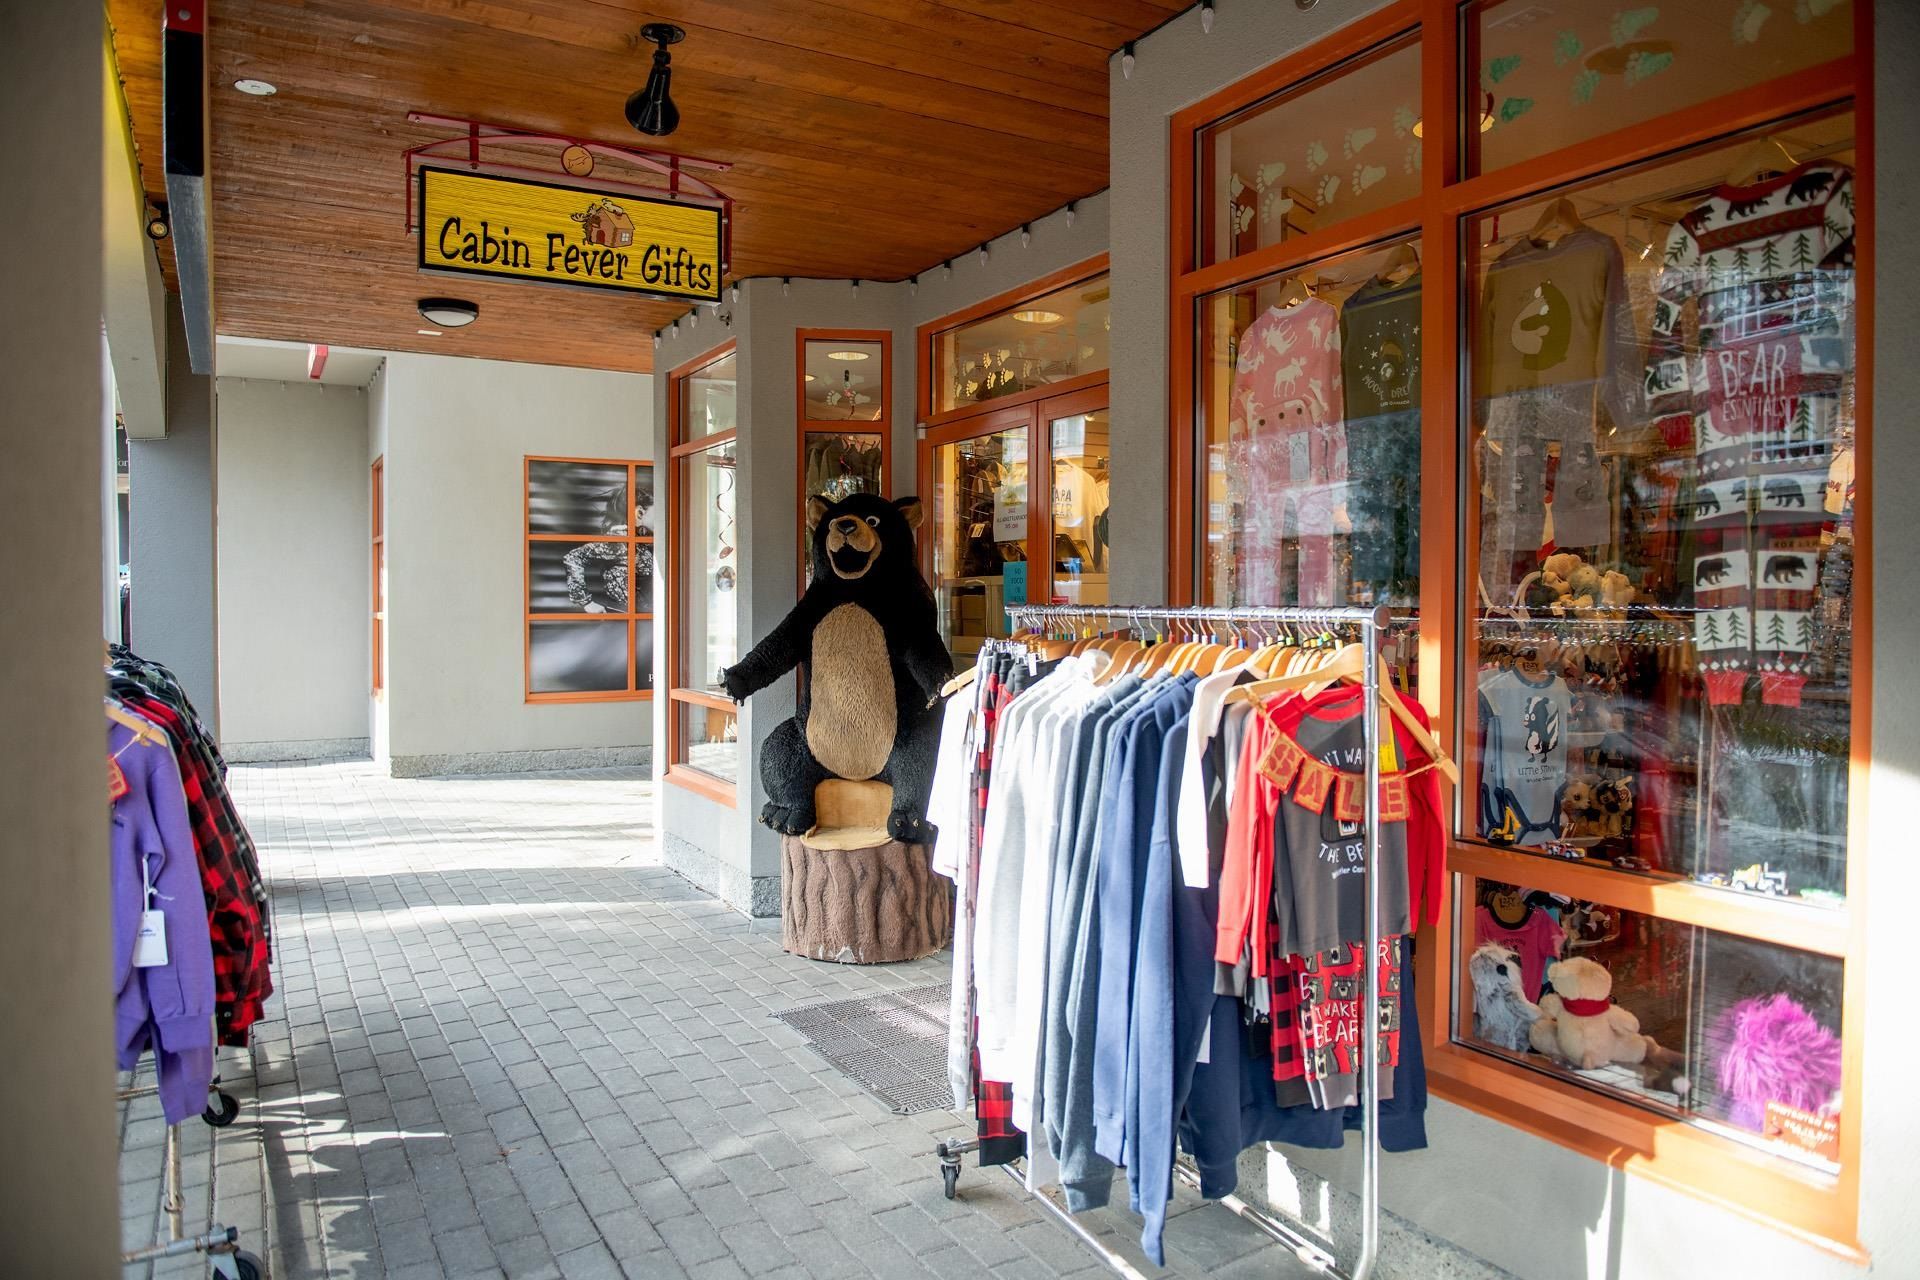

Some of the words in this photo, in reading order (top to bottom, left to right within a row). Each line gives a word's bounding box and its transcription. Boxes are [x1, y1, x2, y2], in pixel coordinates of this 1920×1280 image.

[438, 216, 531, 269] Cabin
[545, 232, 629, 281] Fever
[640, 243, 712, 291] Gifts
[1718, 342, 1787, 399] BEAR
[1722, 395, 1787, 422] ESNTIALS
[1054, 488, 1072, 502] APA
[1344, 747, 1363, 765] WA
[1267, 743, 1405, 814] SALE
[1318, 842, 1340, 864] THE
[1345, 842, 1366, 862] BE
[1324, 1001, 1358, 1018] WAKE
